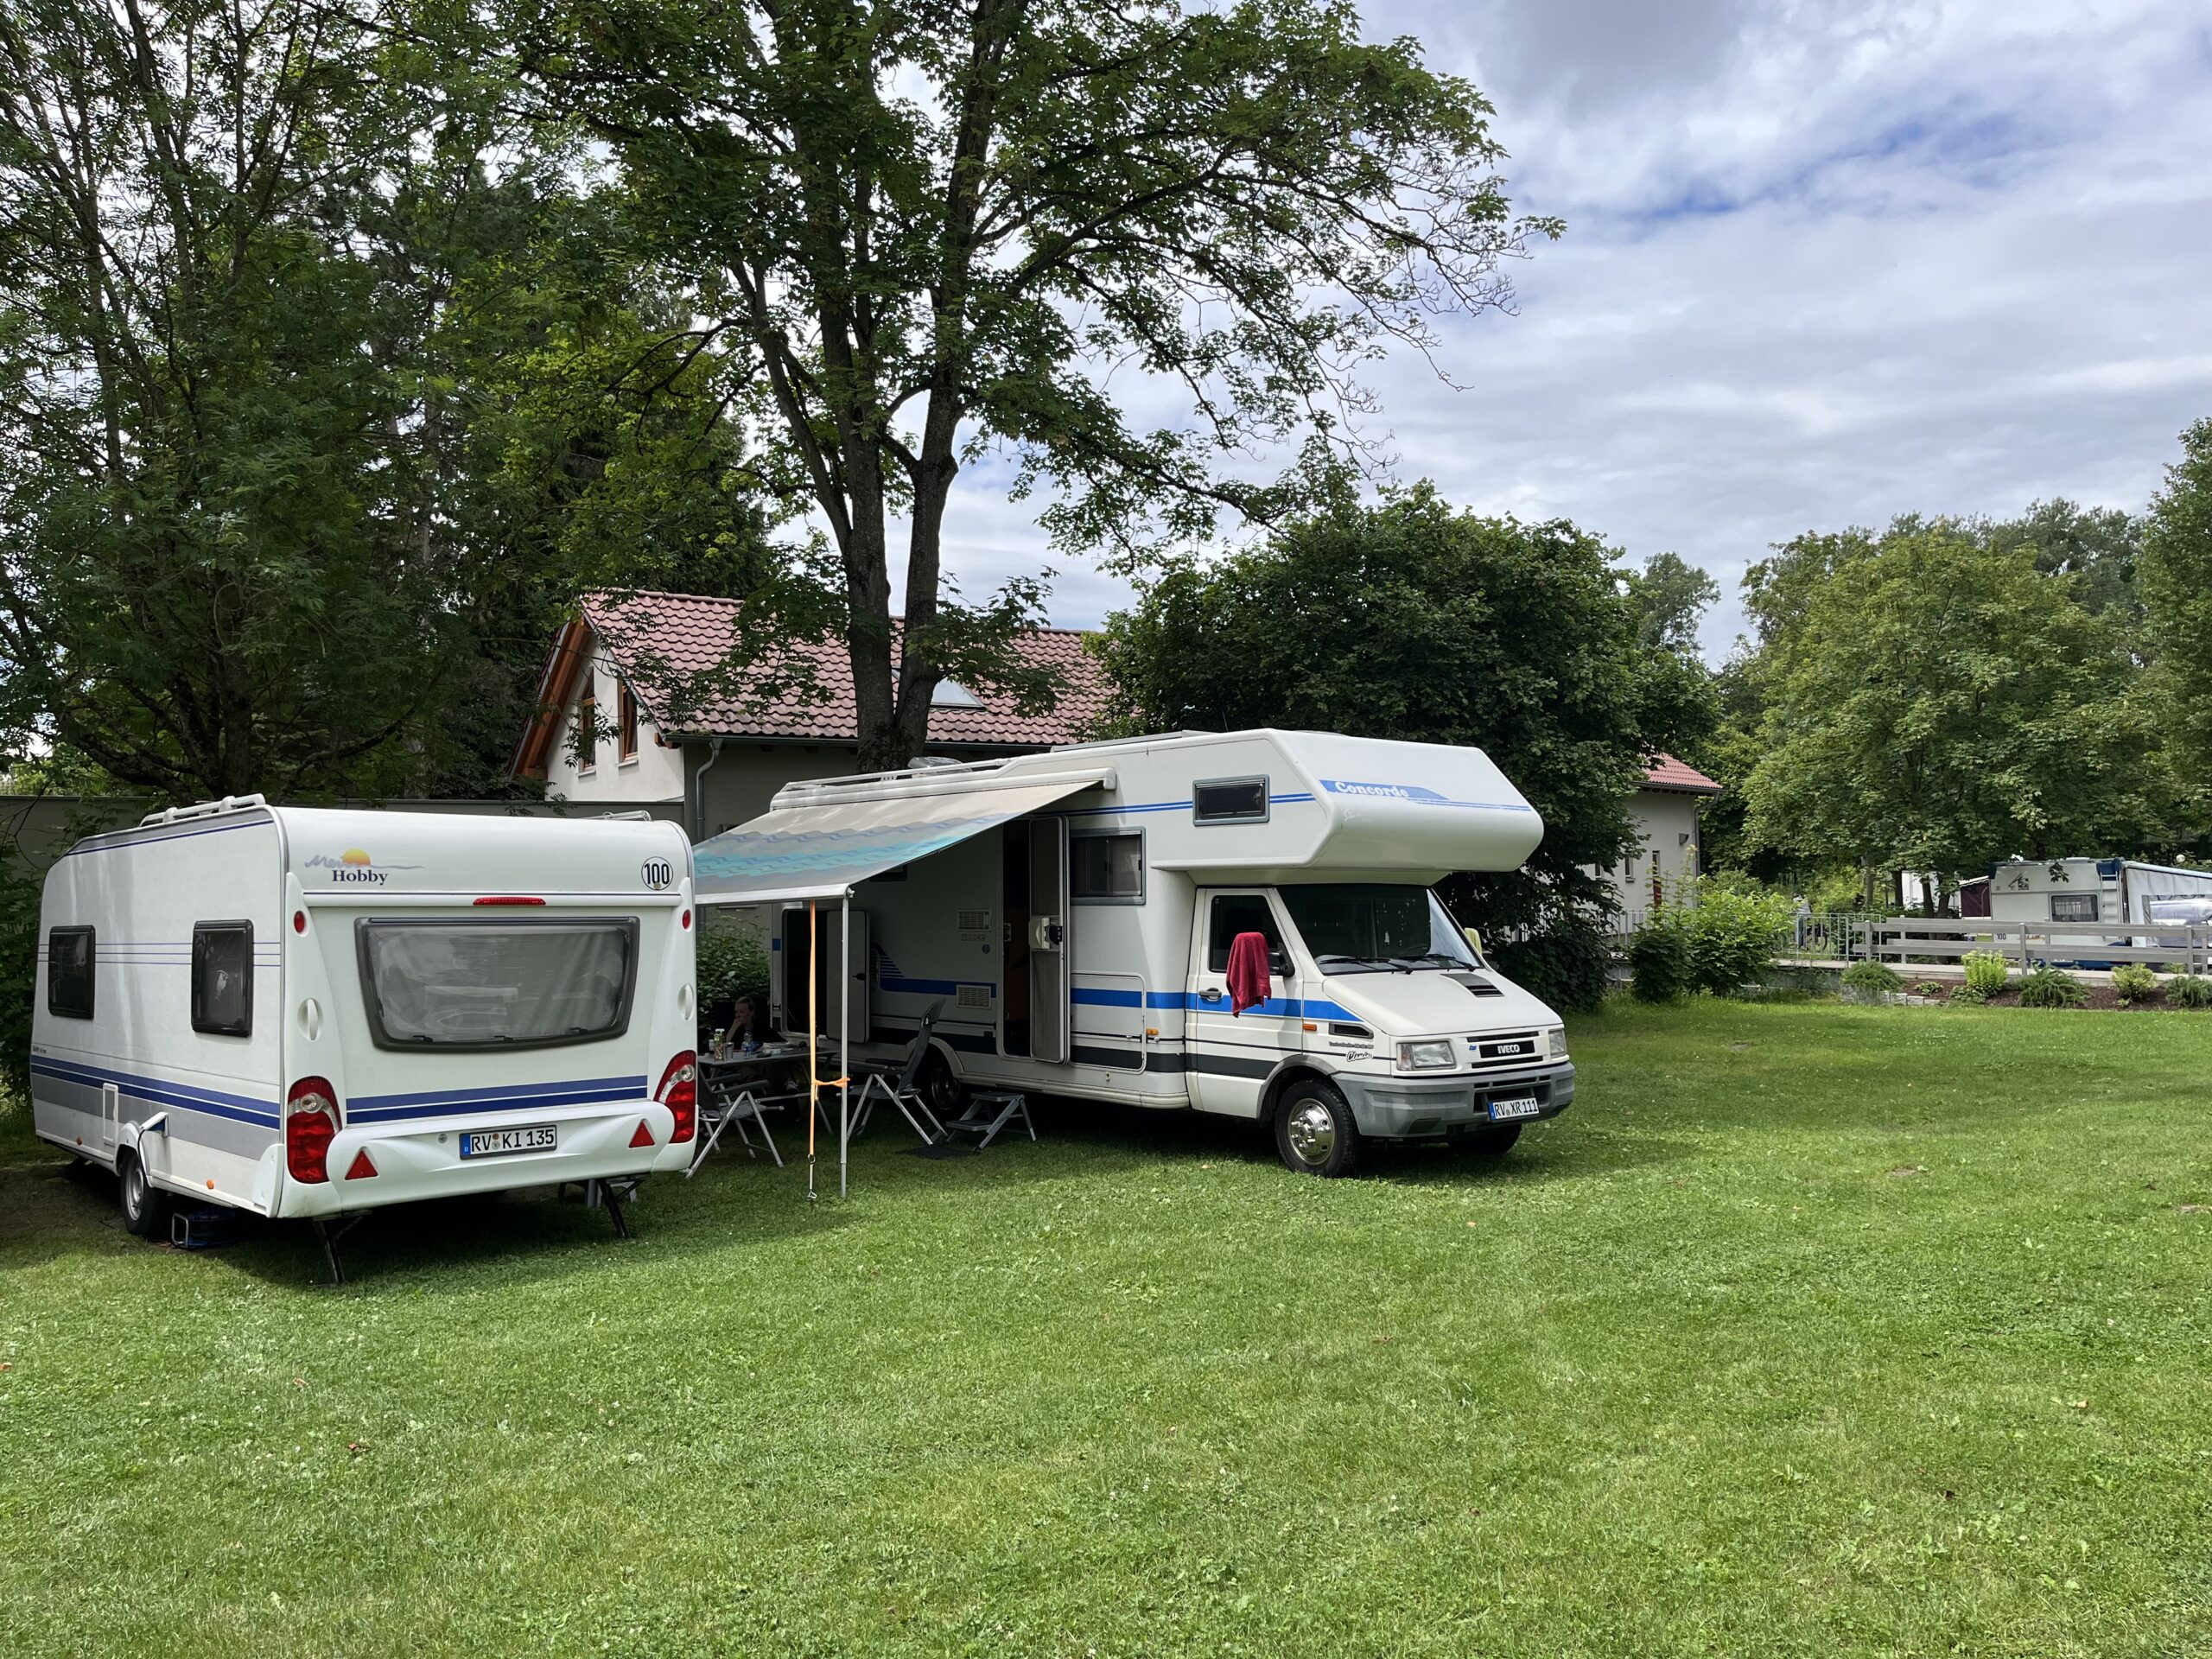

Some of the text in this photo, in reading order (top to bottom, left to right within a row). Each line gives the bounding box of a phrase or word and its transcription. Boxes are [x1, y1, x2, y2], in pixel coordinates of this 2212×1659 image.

[1334, 780, 1410, 798] Concorde
[332, 868, 389, 886] Hobby
[644, 862, 671, 885] 100
[1497, 1044, 1521, 1054] IVECO
[1494, 1099, 1538, 1116] RV XR 111
[471, 1128, 555, 1152] RV KI 135
